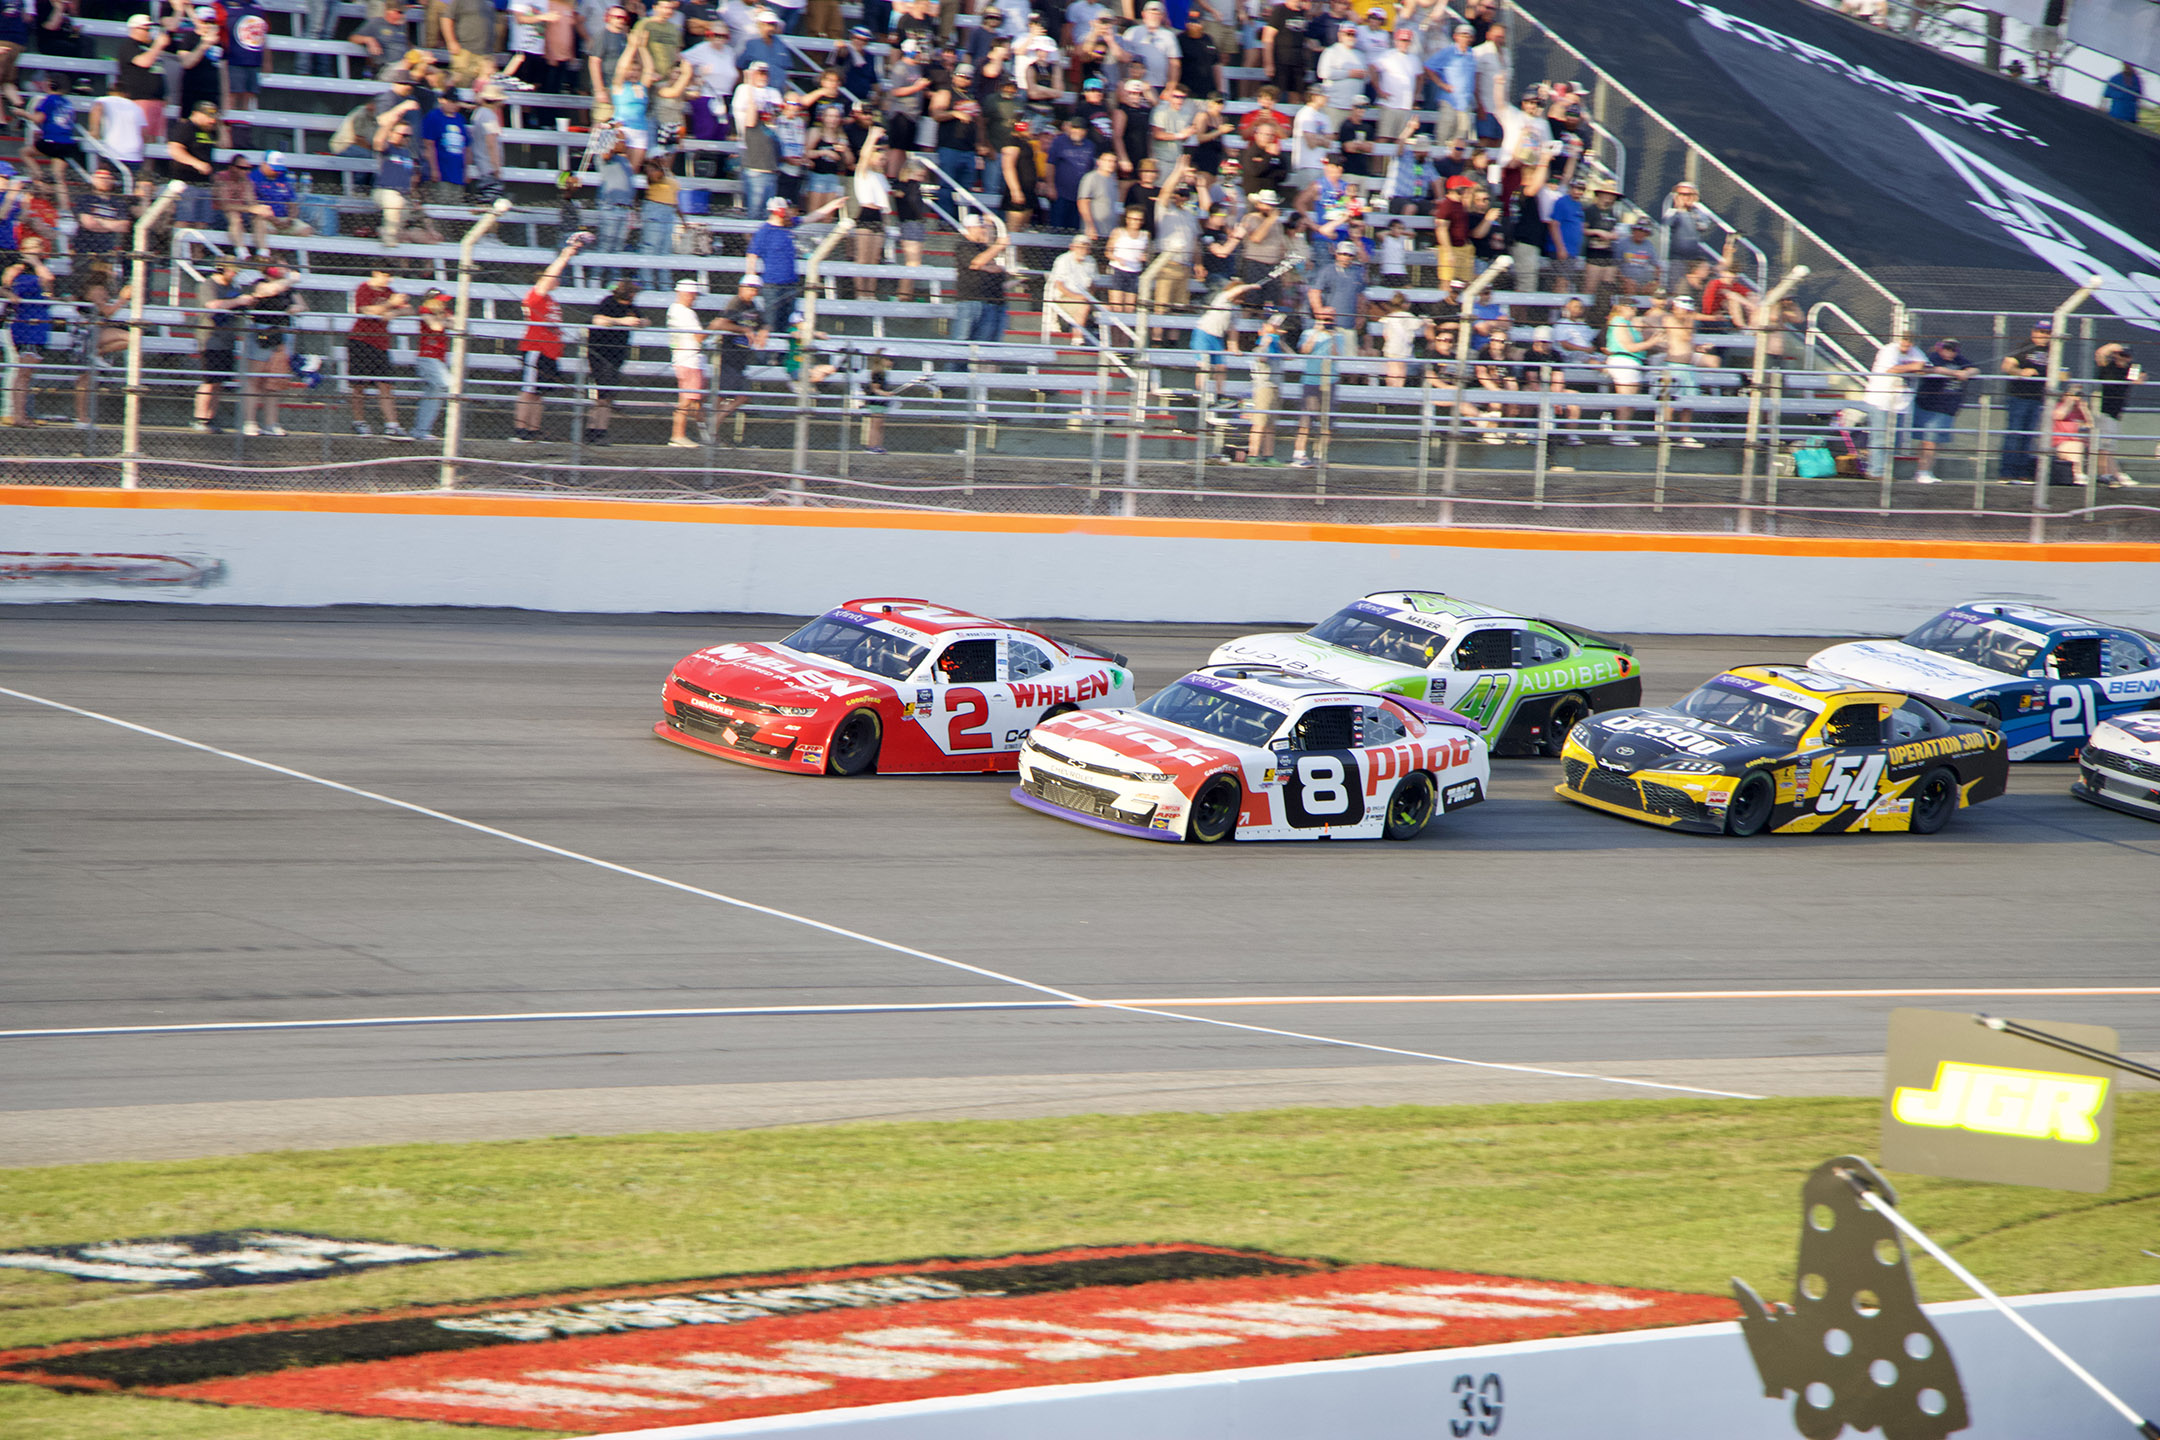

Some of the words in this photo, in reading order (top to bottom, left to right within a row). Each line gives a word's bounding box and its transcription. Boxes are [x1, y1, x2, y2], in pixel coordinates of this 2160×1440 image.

[832, 610, 868, 623] xfinity
[1355, 601, 1389, 614] xfinity
[1406, 615, 1441, 630] MAYER
[891, 626, 917, 639] LOVE
[704, 643, 878, 698] WHELEN
[1220, 645, 1344, 683] AUDIBEL
[1520, 661, 1619, 692] AUDIBEL
[1006, 669, 1109, 709] WHELEN
[1189, 674, 1225, 688] xfinity
[1720, 675, 1756, 688] xfinity
[1780, 691, 1807, 701] GRAY
[2108, 680, 2160, 694] BENN
[691, 698, 735, 716] CHEVROLET
[1232, 686, 1255, 699] DASH
[1262, 695, 1287, 709] CASH
[1449, 673, 1511, 730] 41
[2048, 684, 2097, 738] 21
[944, 686, 993, 751] 2
[1601, 716, 1728, 755] OP300
[1888, 735, 1962, 766] OPERATION
[1959, 731, 1984, 752] 300
[1051, 765, 1094, 782] CHEVROLET
[1204, 764, 1239, 776] GOODYEAR
[1297, 755, 1349, 815] 8
[1815, 754, 1887, 813] 54
[1891, 1061, 2110, 1144] JGR
[1448, 1373, 1504, 1438] 39
